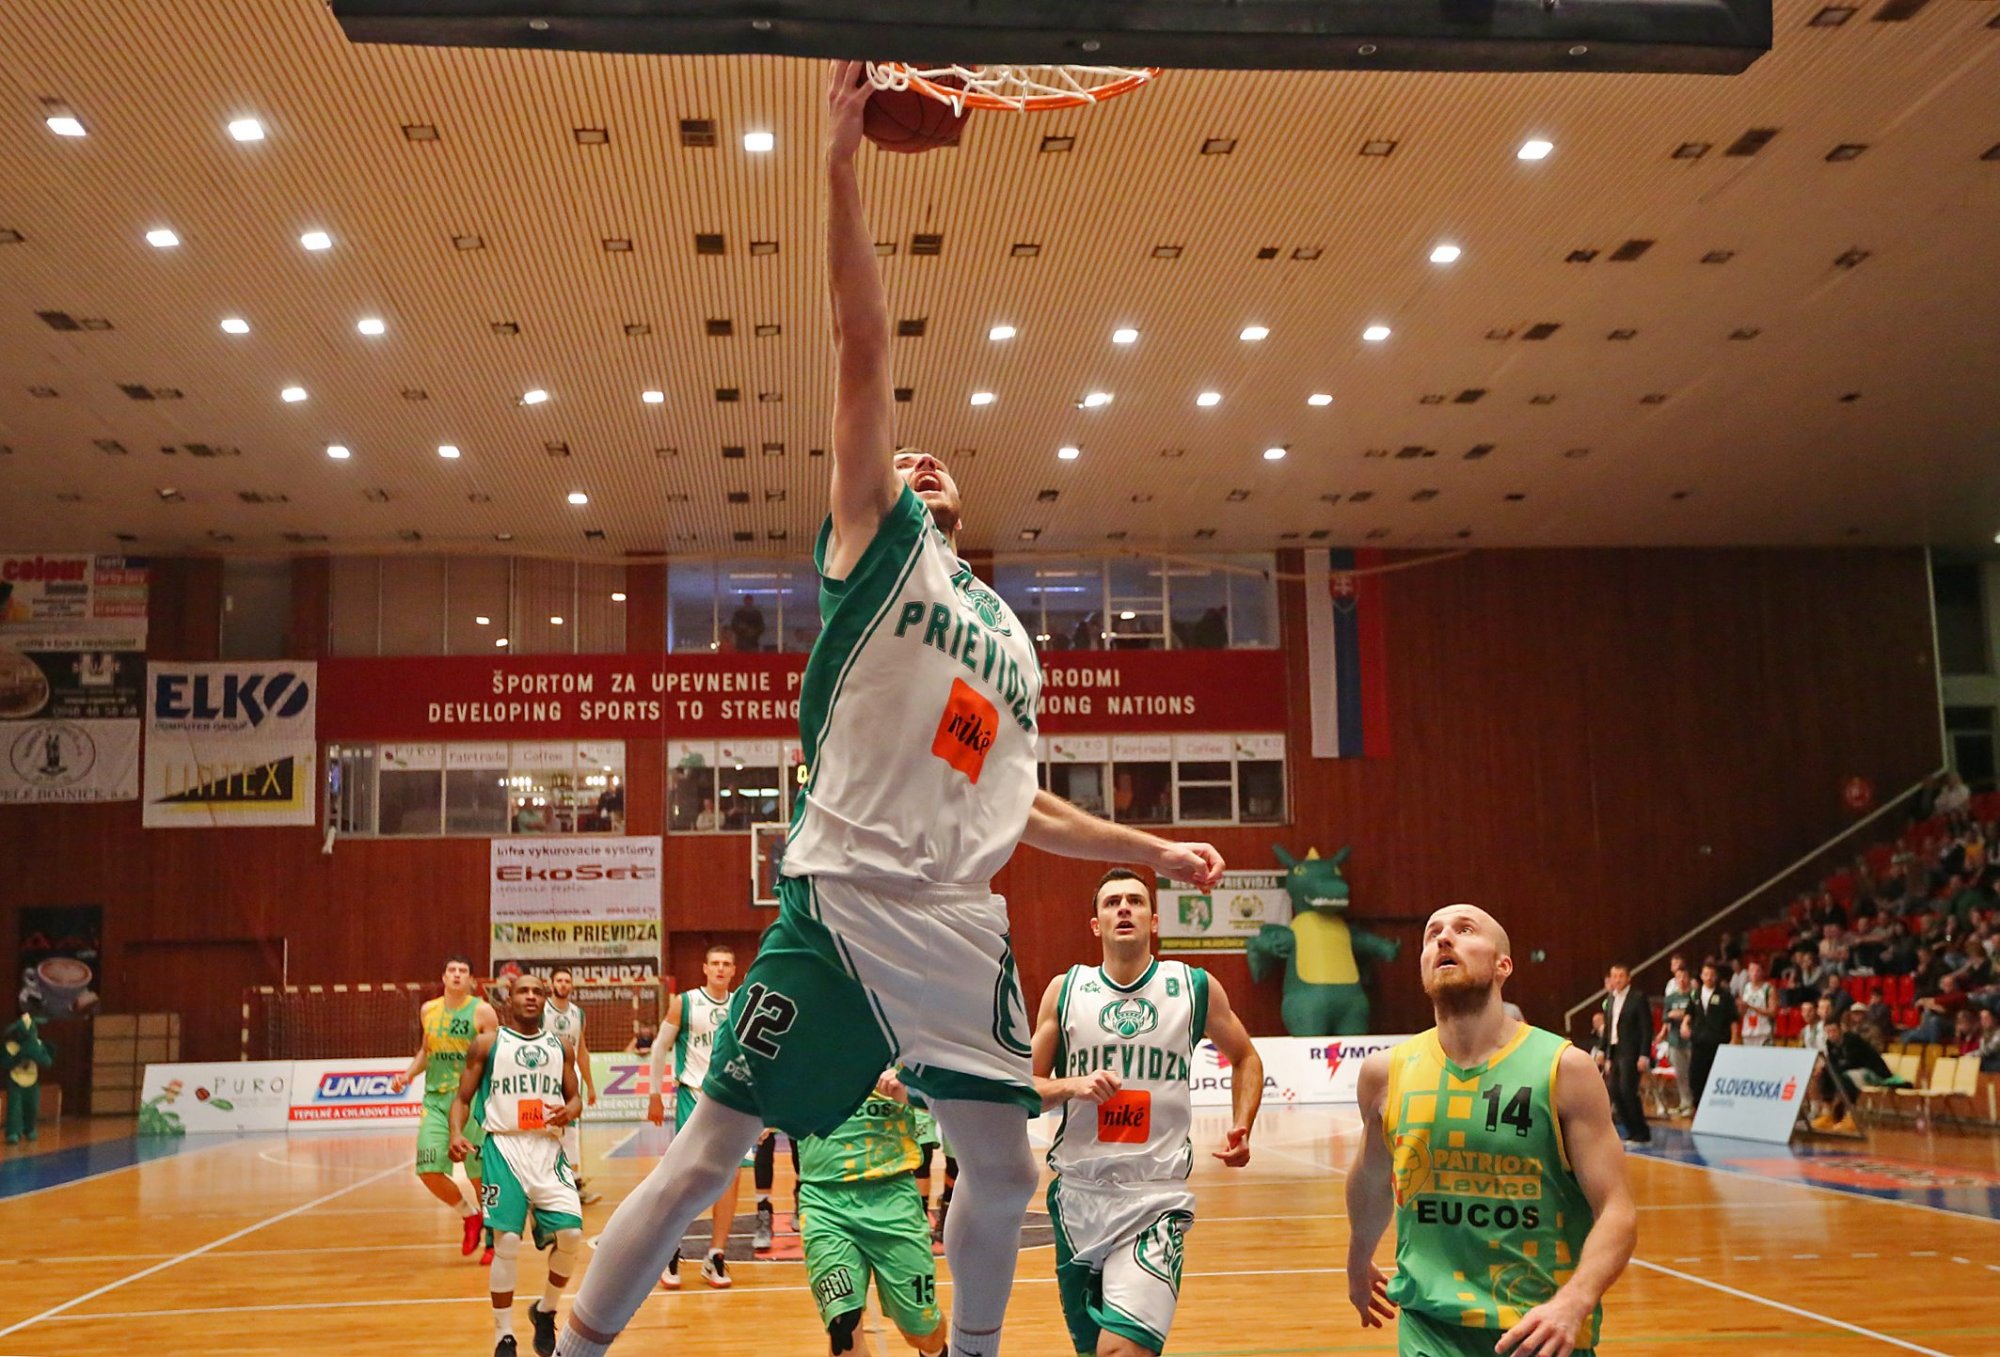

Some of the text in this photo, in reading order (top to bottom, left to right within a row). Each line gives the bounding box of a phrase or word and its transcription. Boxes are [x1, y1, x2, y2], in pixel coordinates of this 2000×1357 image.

[492, 670, 594, 694] ŠPORTOM
[611, 672, 637, 693] ZA
[651, 672, 771, 692] UPEVNENIE
[1042, 663, 1121, 687] ÁRODMI
[155, 673, 310, 728] ELKO
[428, 700, 800, 722] DEVELOPING SPORTS TO STRENG
[1036, 696, 1197, 715] MONG NATIONS
[947, 712, 991, 756] niké
[496, 864, 655, 882] EkoSet
[516, 924, 658, 943] Mesto PRIEVIDZA
[569, 966, 654, 982] RIEVIDZA
[450, 1018, 470, 1035] 23
[734, 981, 799, 1060] 12
[1069, 1044, 1188, 1081] PRIEVIDZA
[214, 1076, 285, 1095] PURO
[322, 1075, 406, 1097] UNIC
[1189, 1076, 1278, 1091] UROA
[1713, 1077, 1782, 1100] SLOVENSKÁ
[1104, 1107, 1145, 1128] niké
[1481, 1084, 1533, 1138] 14
[1434, 1173, 1538, 1196] Levice
[1417, 1200, 1540, 1230] EUCOS
[912, 1274, 935, 1306] 15
